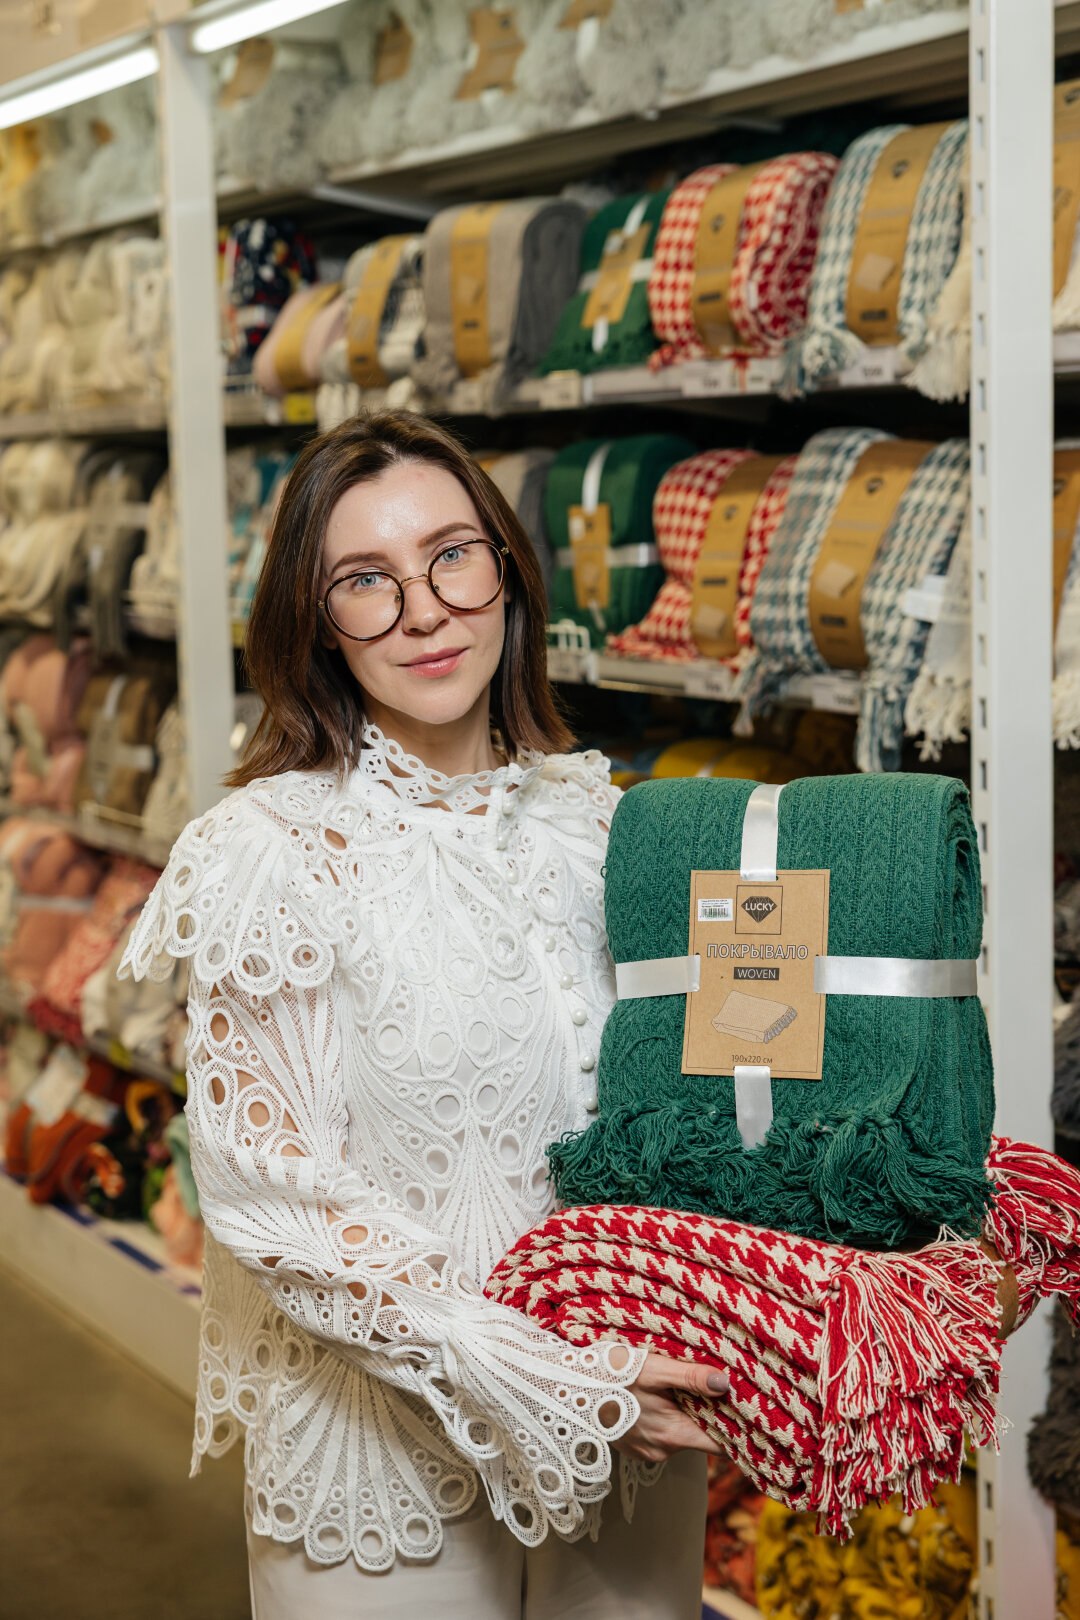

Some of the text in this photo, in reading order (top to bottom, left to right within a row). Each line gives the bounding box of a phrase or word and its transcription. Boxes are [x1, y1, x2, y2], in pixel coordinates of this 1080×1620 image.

[745, 902, 774, 911] LUCKY
[707, 943, 808, 960] ПОКРЫВАЛО
[737, 968, 776, 979] WOVEN
